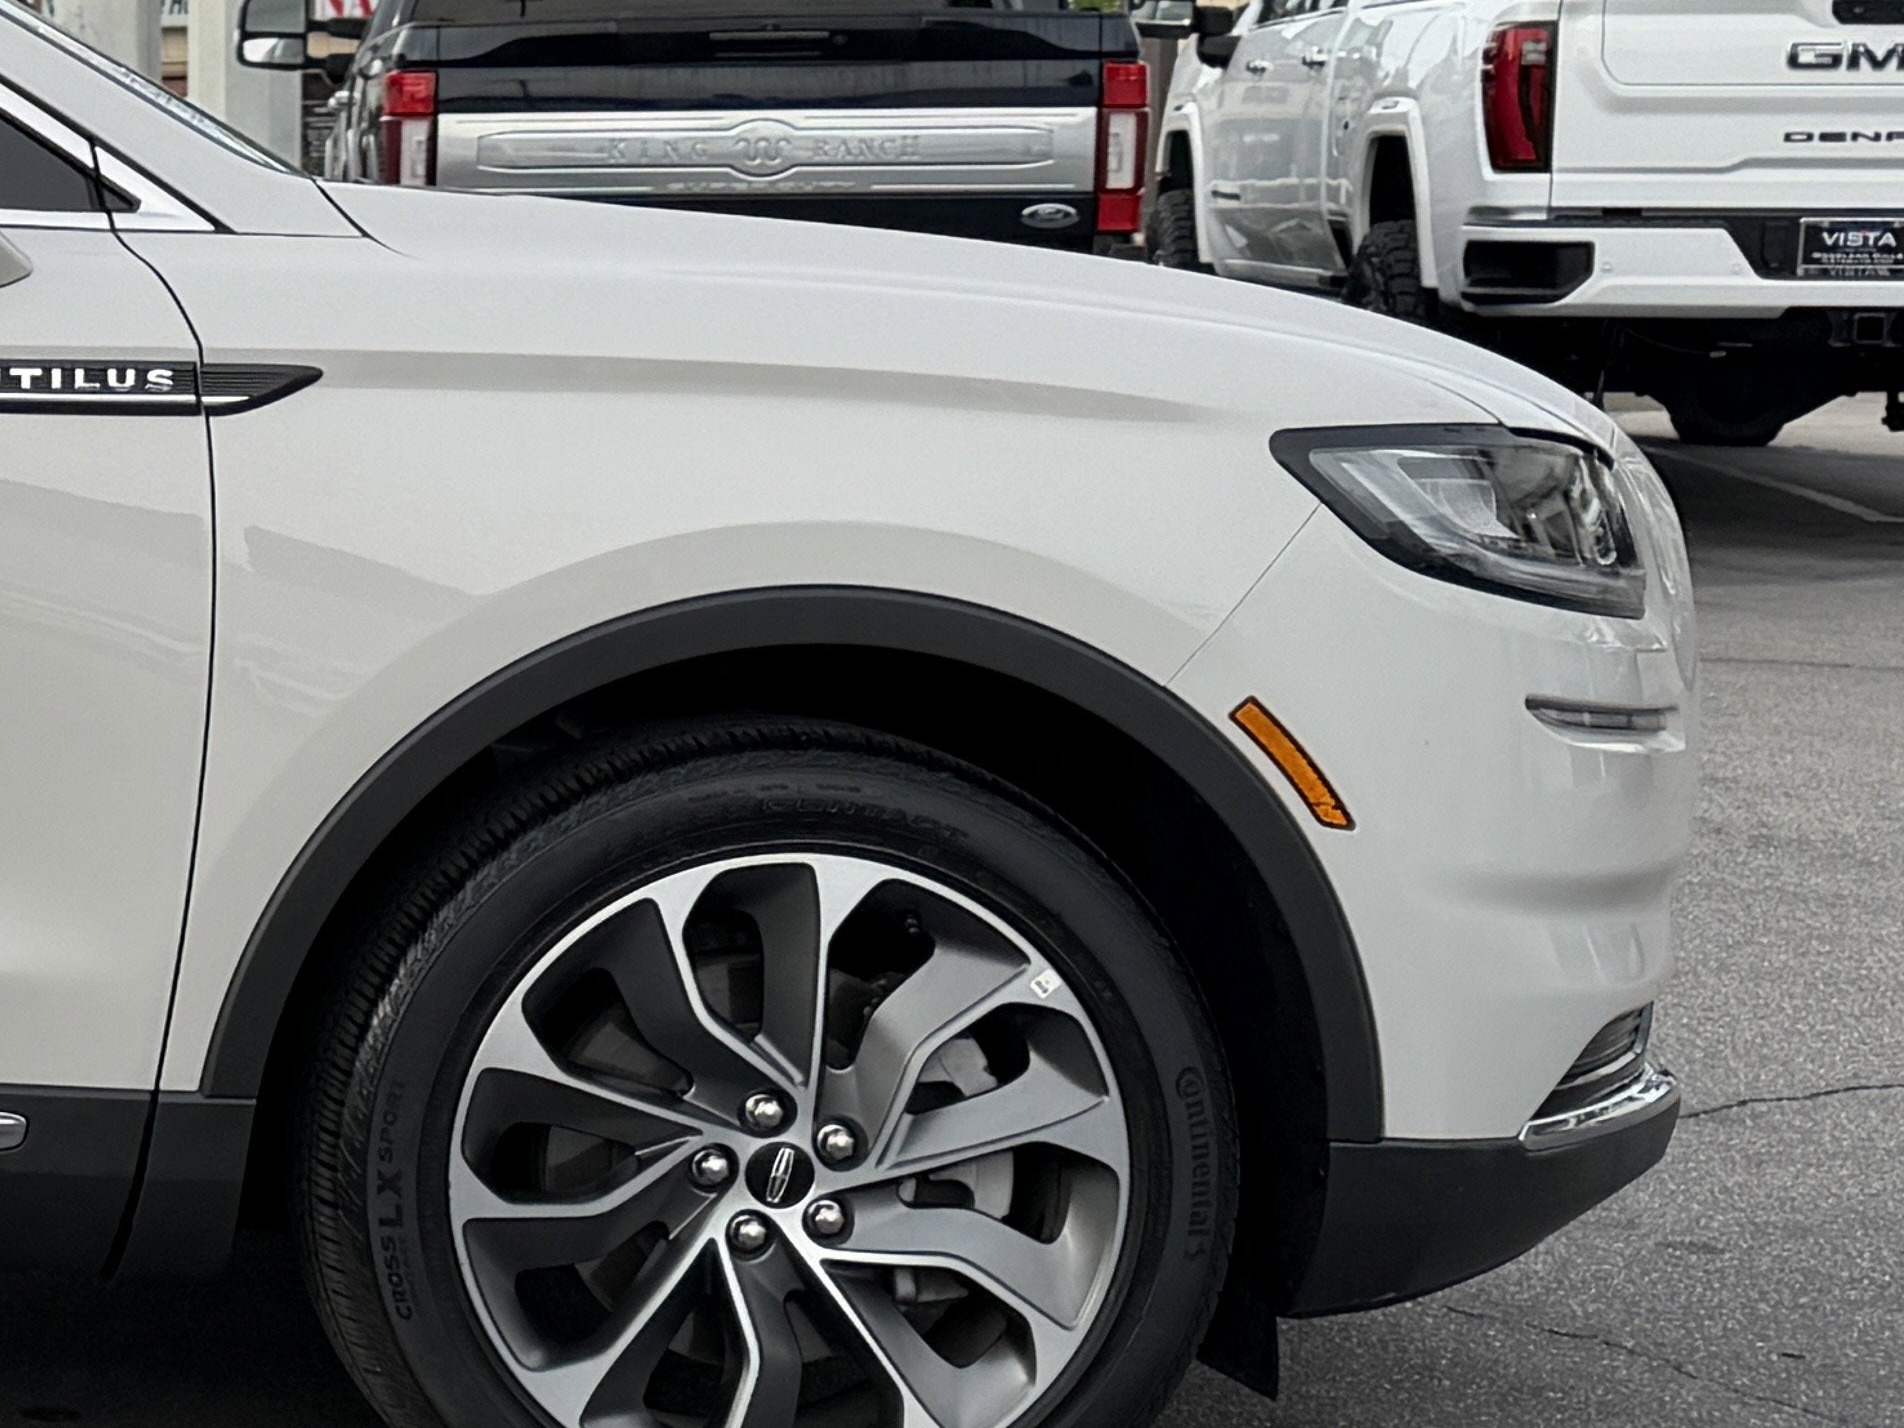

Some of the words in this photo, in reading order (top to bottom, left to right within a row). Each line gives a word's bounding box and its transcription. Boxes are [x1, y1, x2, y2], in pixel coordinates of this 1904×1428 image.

[1786, 41, 1904, 71] GM
[1784, 131, 1904, 143] DENA
[605, 137, 709, 161] KING
[813, 135, 923, 160] RANCH
[1822, 231, 1897, 247] VISTA
